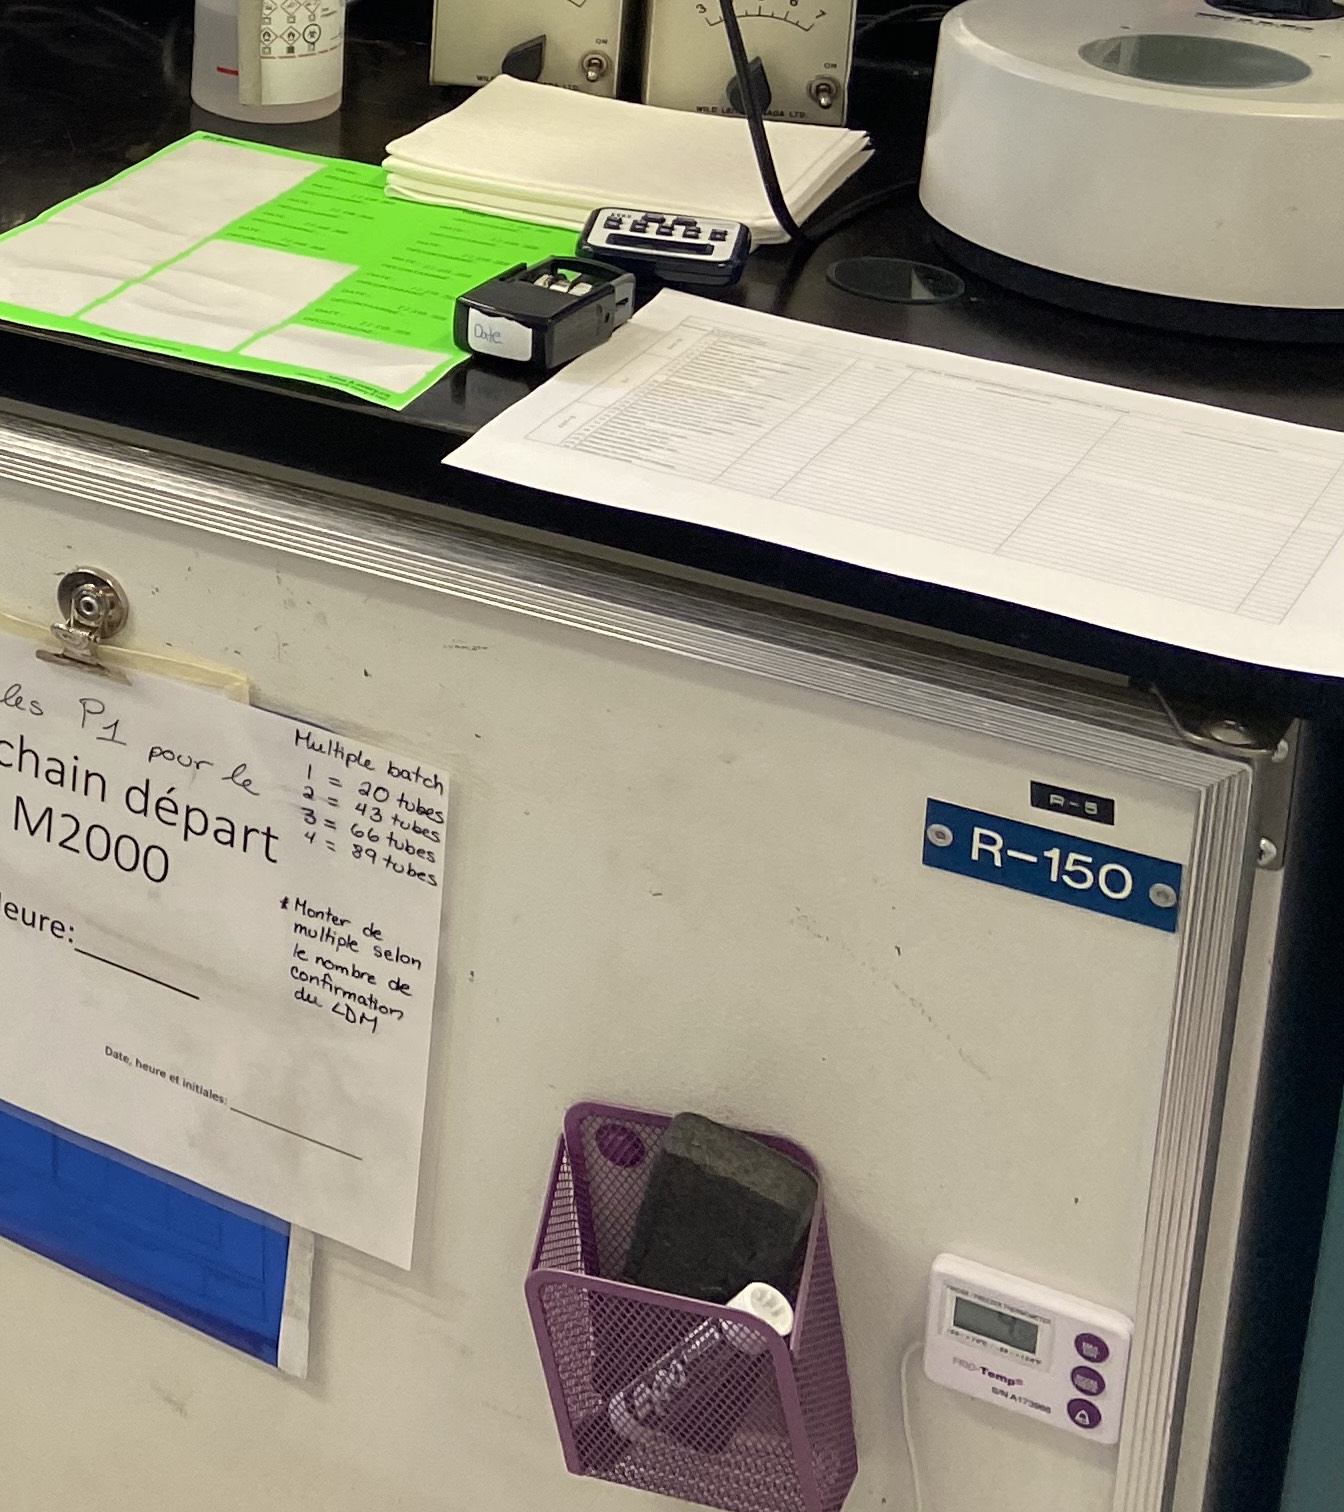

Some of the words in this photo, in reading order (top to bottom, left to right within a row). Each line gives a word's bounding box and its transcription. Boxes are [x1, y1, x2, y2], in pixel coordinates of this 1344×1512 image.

[695, 3, 708, 14] 3
[815, 9, 828, 20] 7
[473, 323, 504, 345] Date
[79, 696, 127, 747] P1
[148, 745, 214, 785] pour
[221, 758, 261, 796] le
[294, 728, 376, 771] Multiple
[387, 760, 445, 796] batch
[124, 776, 281, 866] départ
[302, 785, 315, 800] 2
[354, 802, 383, 823] 43
[391, 813, 441, 844] tubes
[357, 781, 390, 803] 20
[396, 792, 445, 824] tubes
[12, 793, 171, 885] M2000
[300, 806, 317, 825] 3
[350, 823, 380, 843] 66
[386, 831, 436, 864] tubes
[304, 831, 317, 844] 4
[351, 843, 377, 865] 89
[382, 854, 438, 887] tubes
[970, 825, 1134, 900] R-150
[293, 922, 360, 953] multiple
[373, 945, 422, 971] selon
[294, 897, 352, 927] Monter
[362, 922, 384, 941] de
[292, 943, 309, 962] le
[315, 955, 377, 985] nombre
[387, 977, 413, 997] de
[294, 986, 324, 1008] du
[331, 1002, 378, 1035] LDM
[135, 1057, 167, 1079] heure
[169, 1073, 180, 1086] et
